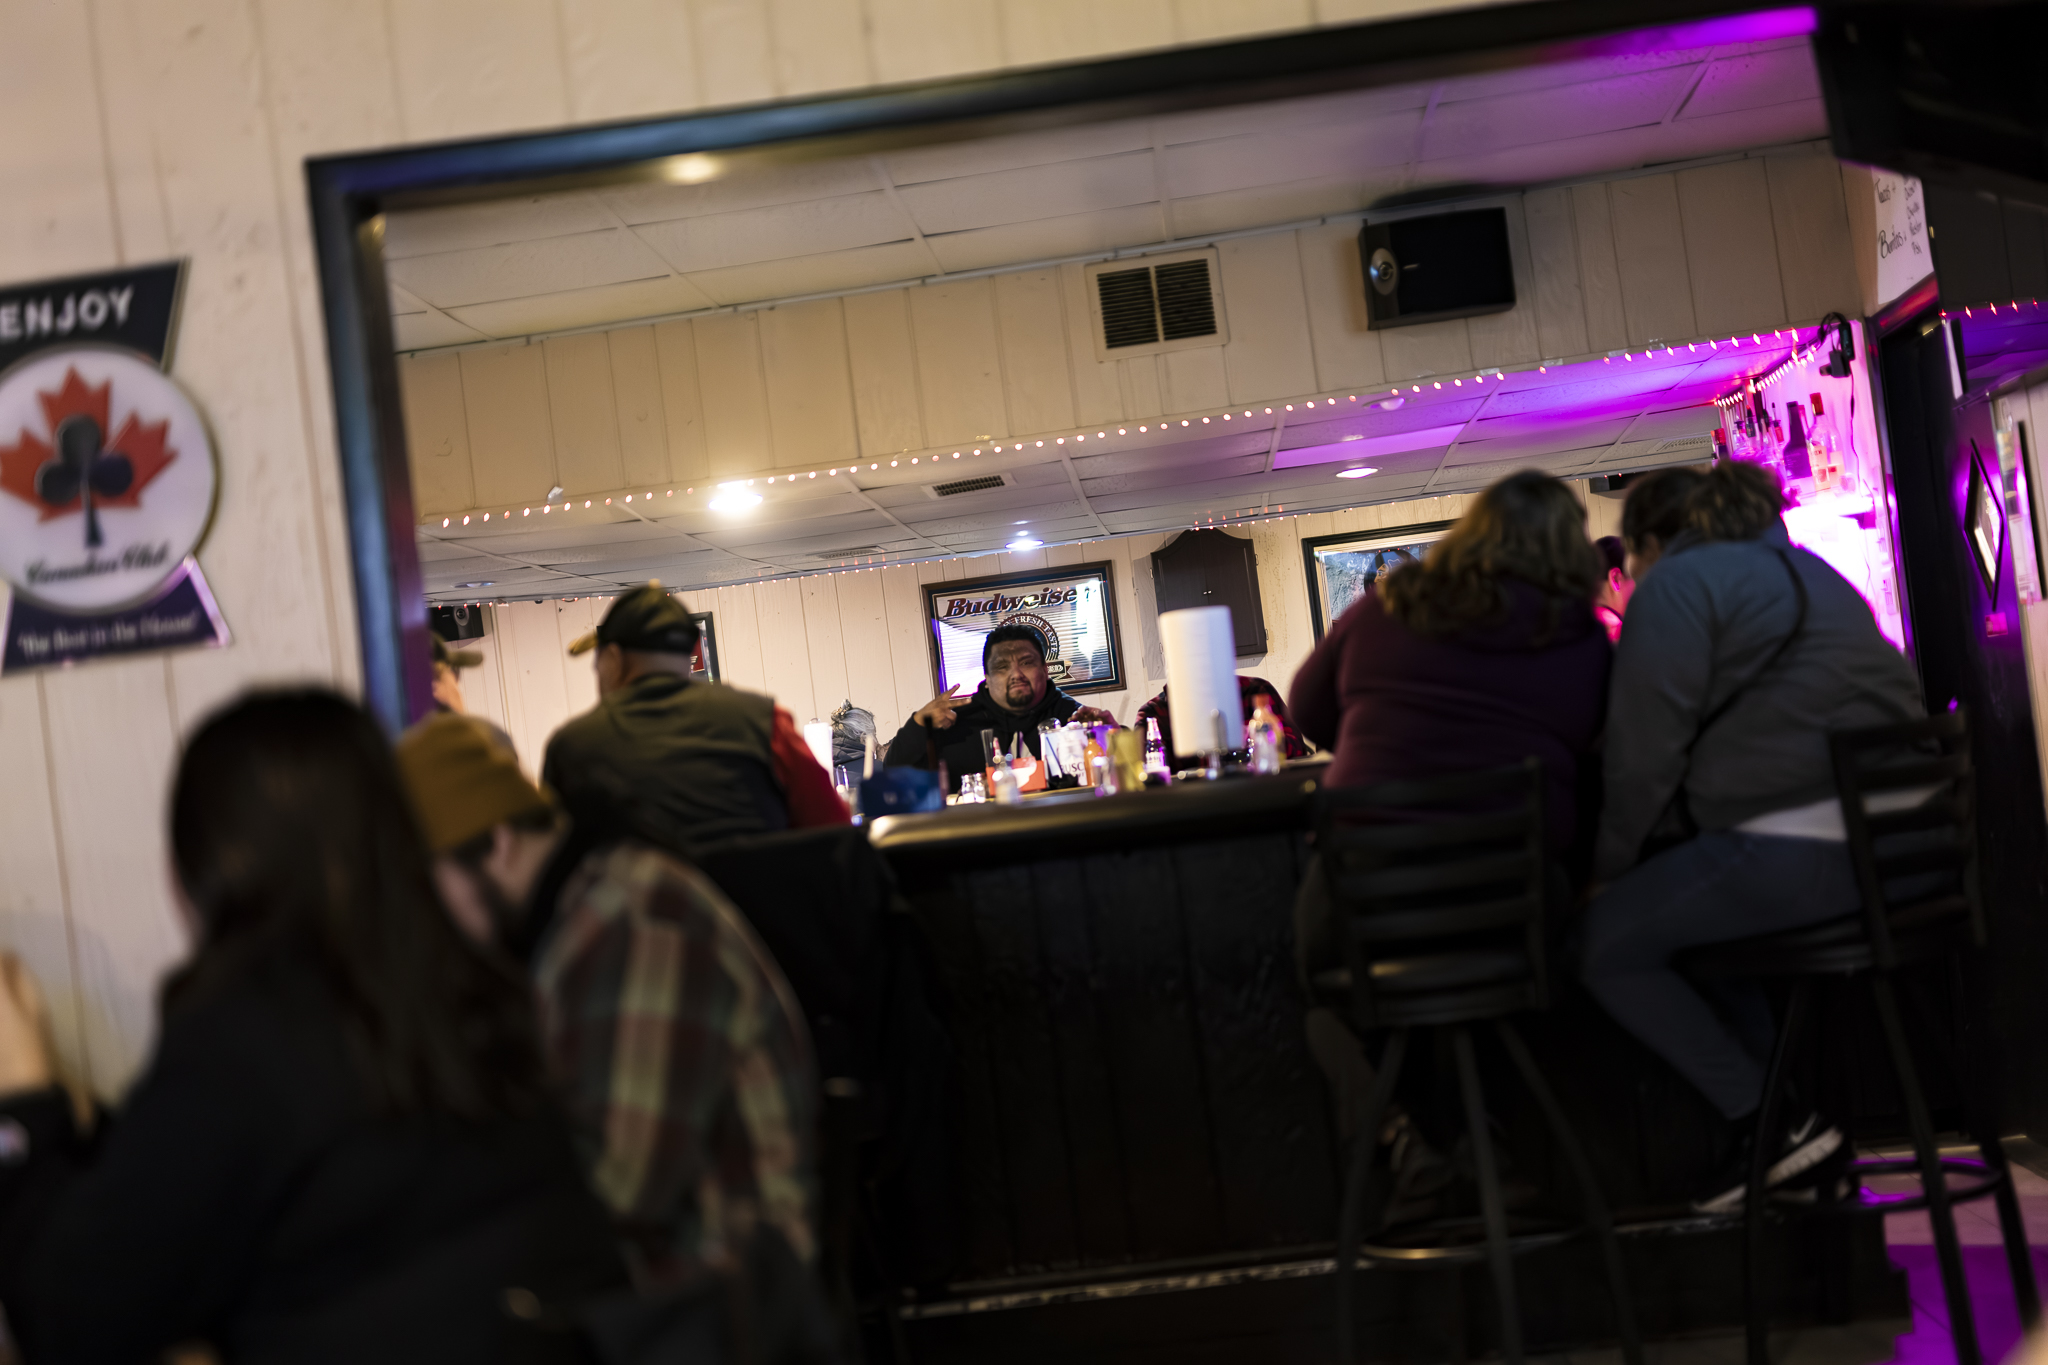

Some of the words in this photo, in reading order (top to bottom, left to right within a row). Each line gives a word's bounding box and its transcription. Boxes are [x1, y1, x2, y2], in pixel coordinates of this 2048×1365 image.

[0, 287, 133, 341] ENJOY
[1014, 615, 1043, 627] FRESH
[1044, 624, 1058, 653] TASTE
